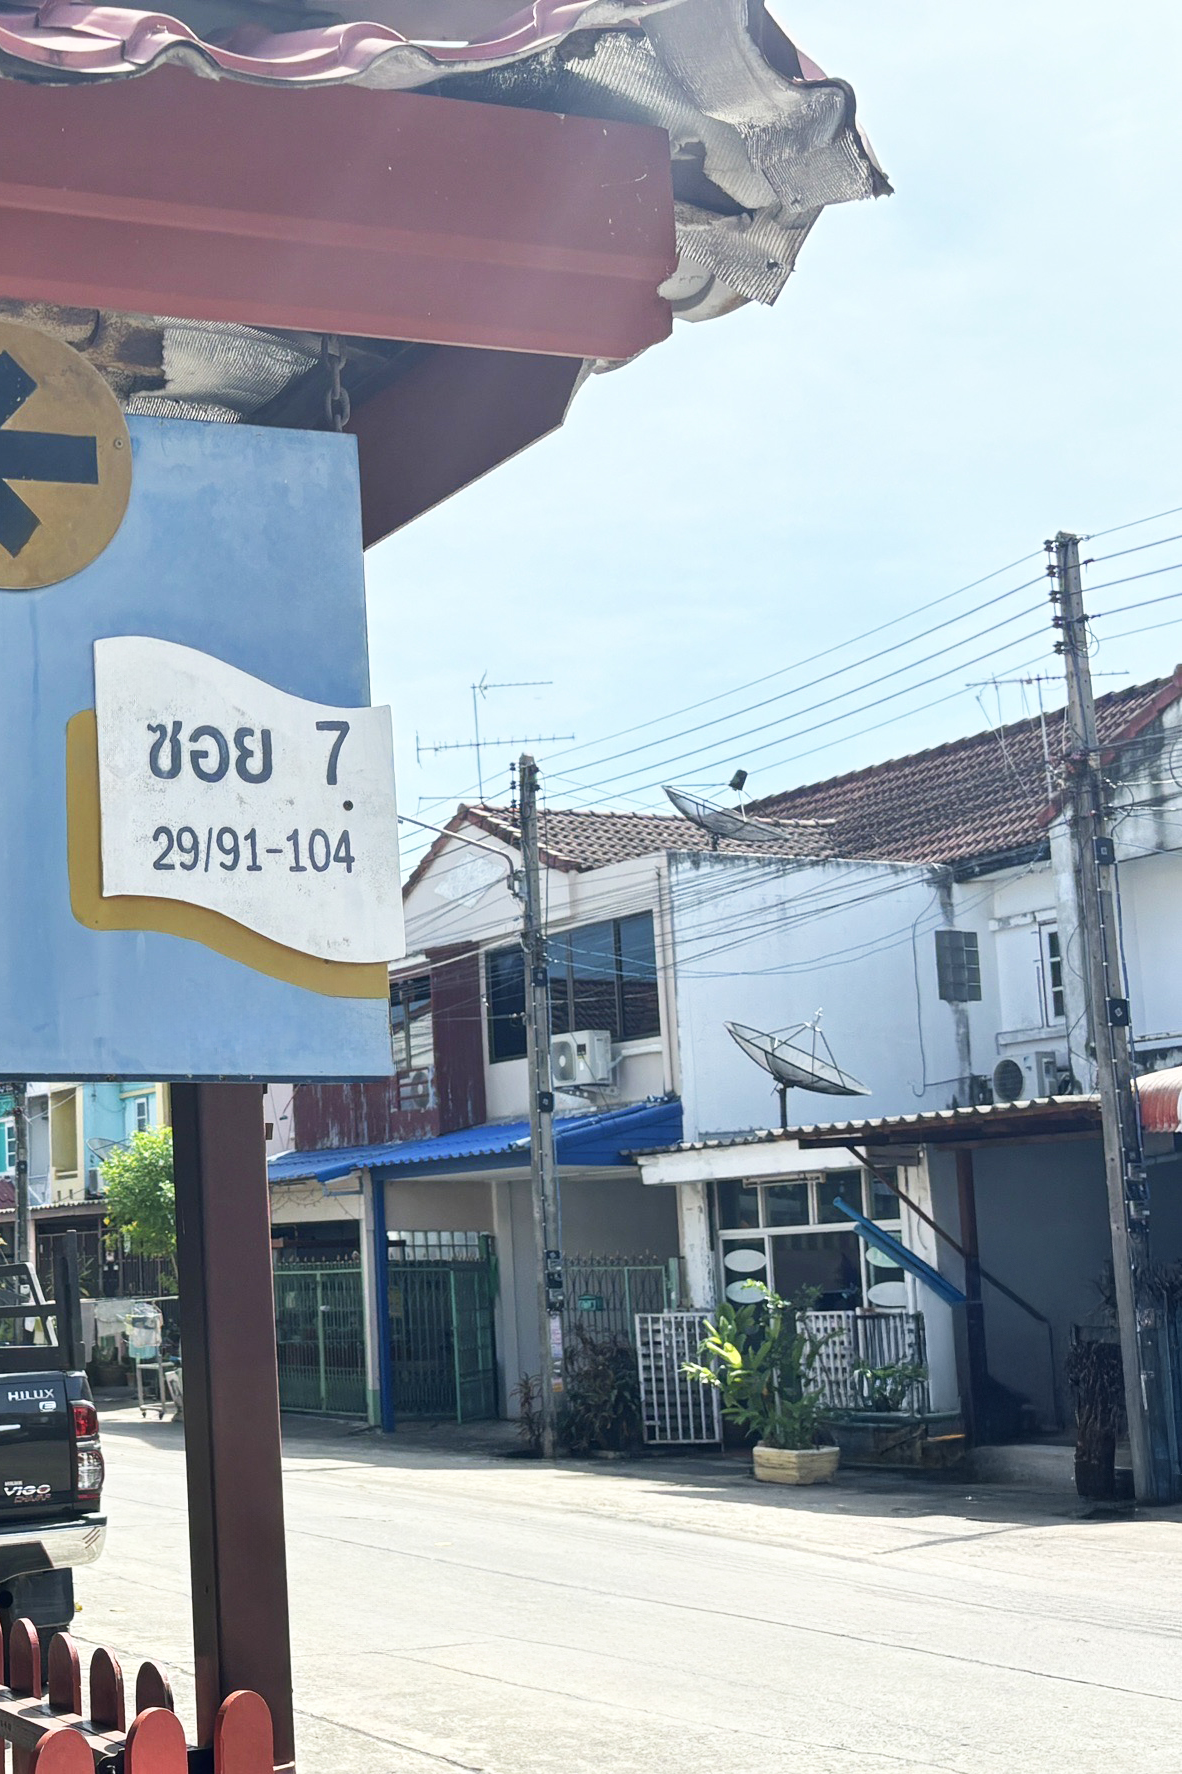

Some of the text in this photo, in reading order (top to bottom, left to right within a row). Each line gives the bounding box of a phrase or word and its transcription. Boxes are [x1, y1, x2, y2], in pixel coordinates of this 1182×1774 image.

[147, 721, 350, 785] ซอย 7
[152, 826, 355, 873] 29/91-104
[8, 1388, 55, 1401] HILUX
[3, 1484, 51, 1496] VIGO
